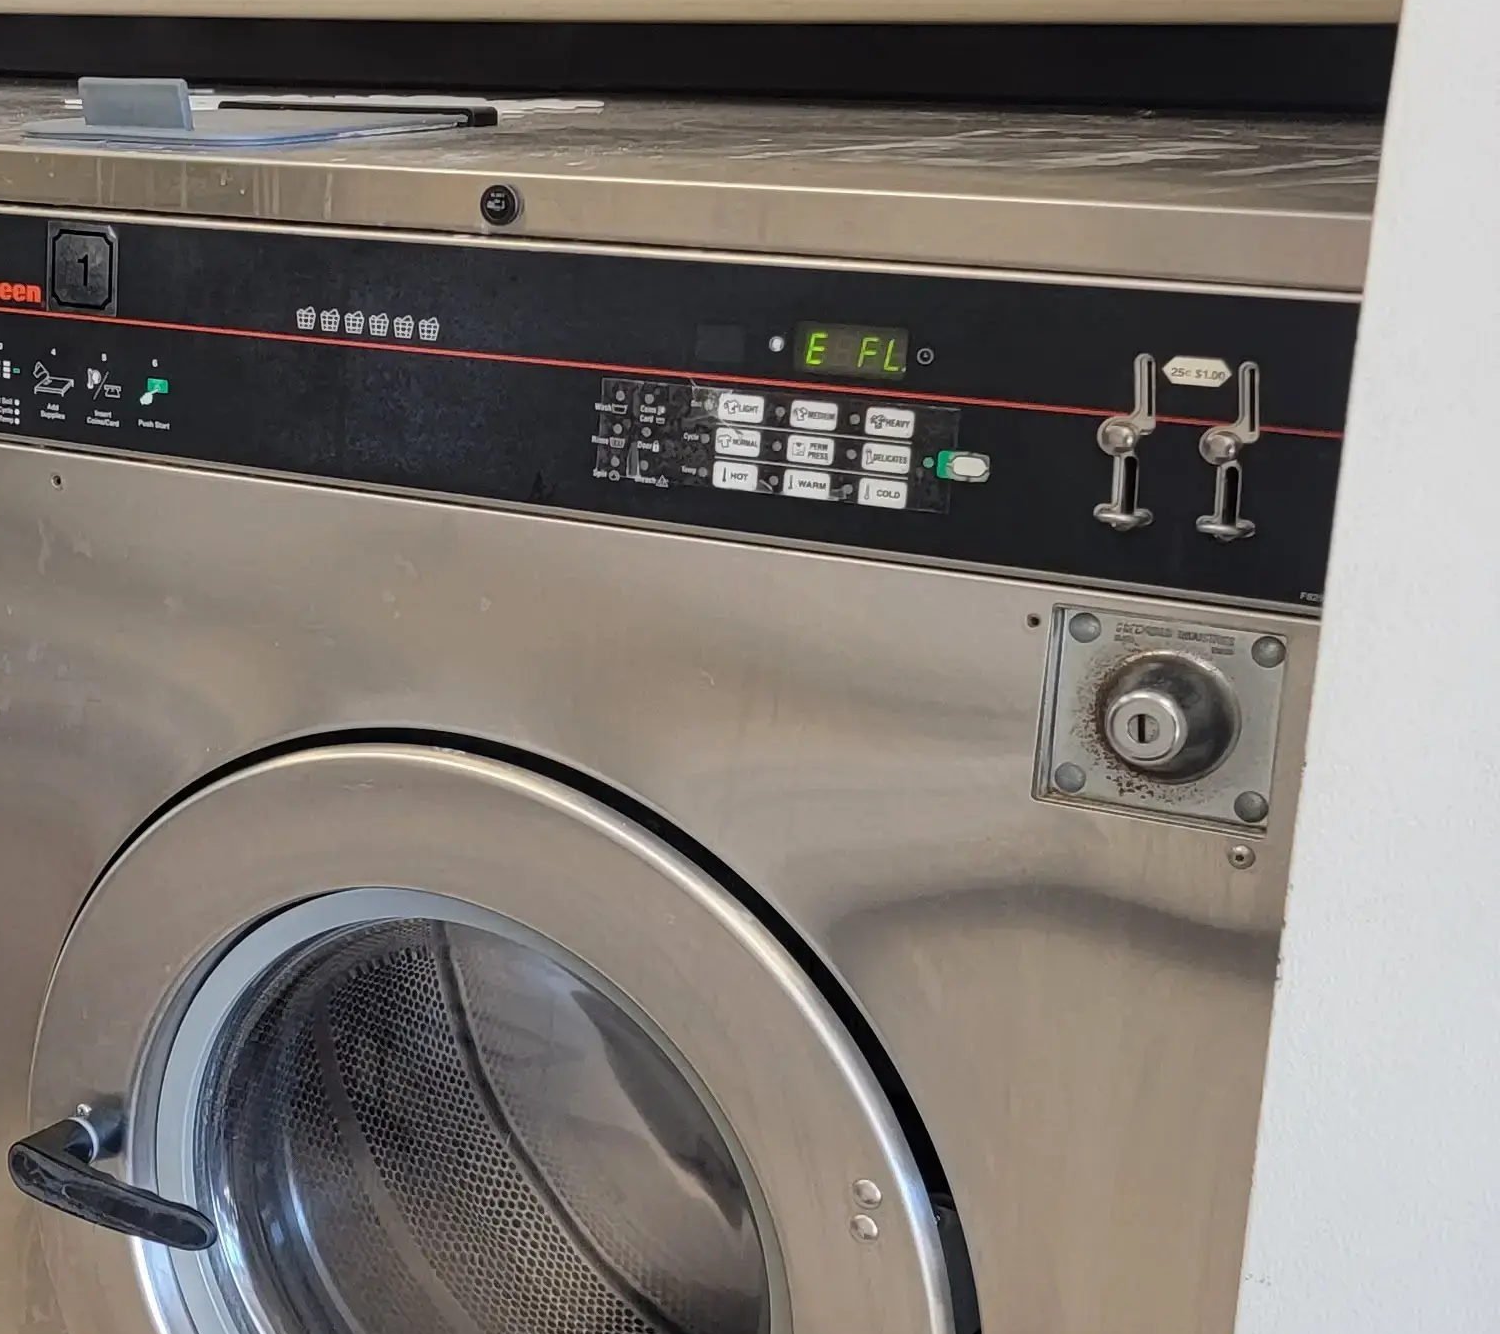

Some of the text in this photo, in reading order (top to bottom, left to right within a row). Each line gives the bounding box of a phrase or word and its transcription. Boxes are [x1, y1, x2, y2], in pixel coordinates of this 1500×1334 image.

[77, 254, 90, 287] 1
[50, 348, 56, 356] 4
[806, 332, 828, 366] E
[152, 359, 158, 367] 6
[1194, 369, 1226, 381] $1.00
[886, 419, 911, 428] HEAVY
[683, 432, 699, 441] Cycle
[809, 442, 829, 451] PERM
[808, 452, 829, 460] PRESS
[873, 454, 908, 465] DELICATES
[730, 472, 749, 481] HOT
[798, 480, 827, 490] WARM
[876, 489, 901, 499] COLD
